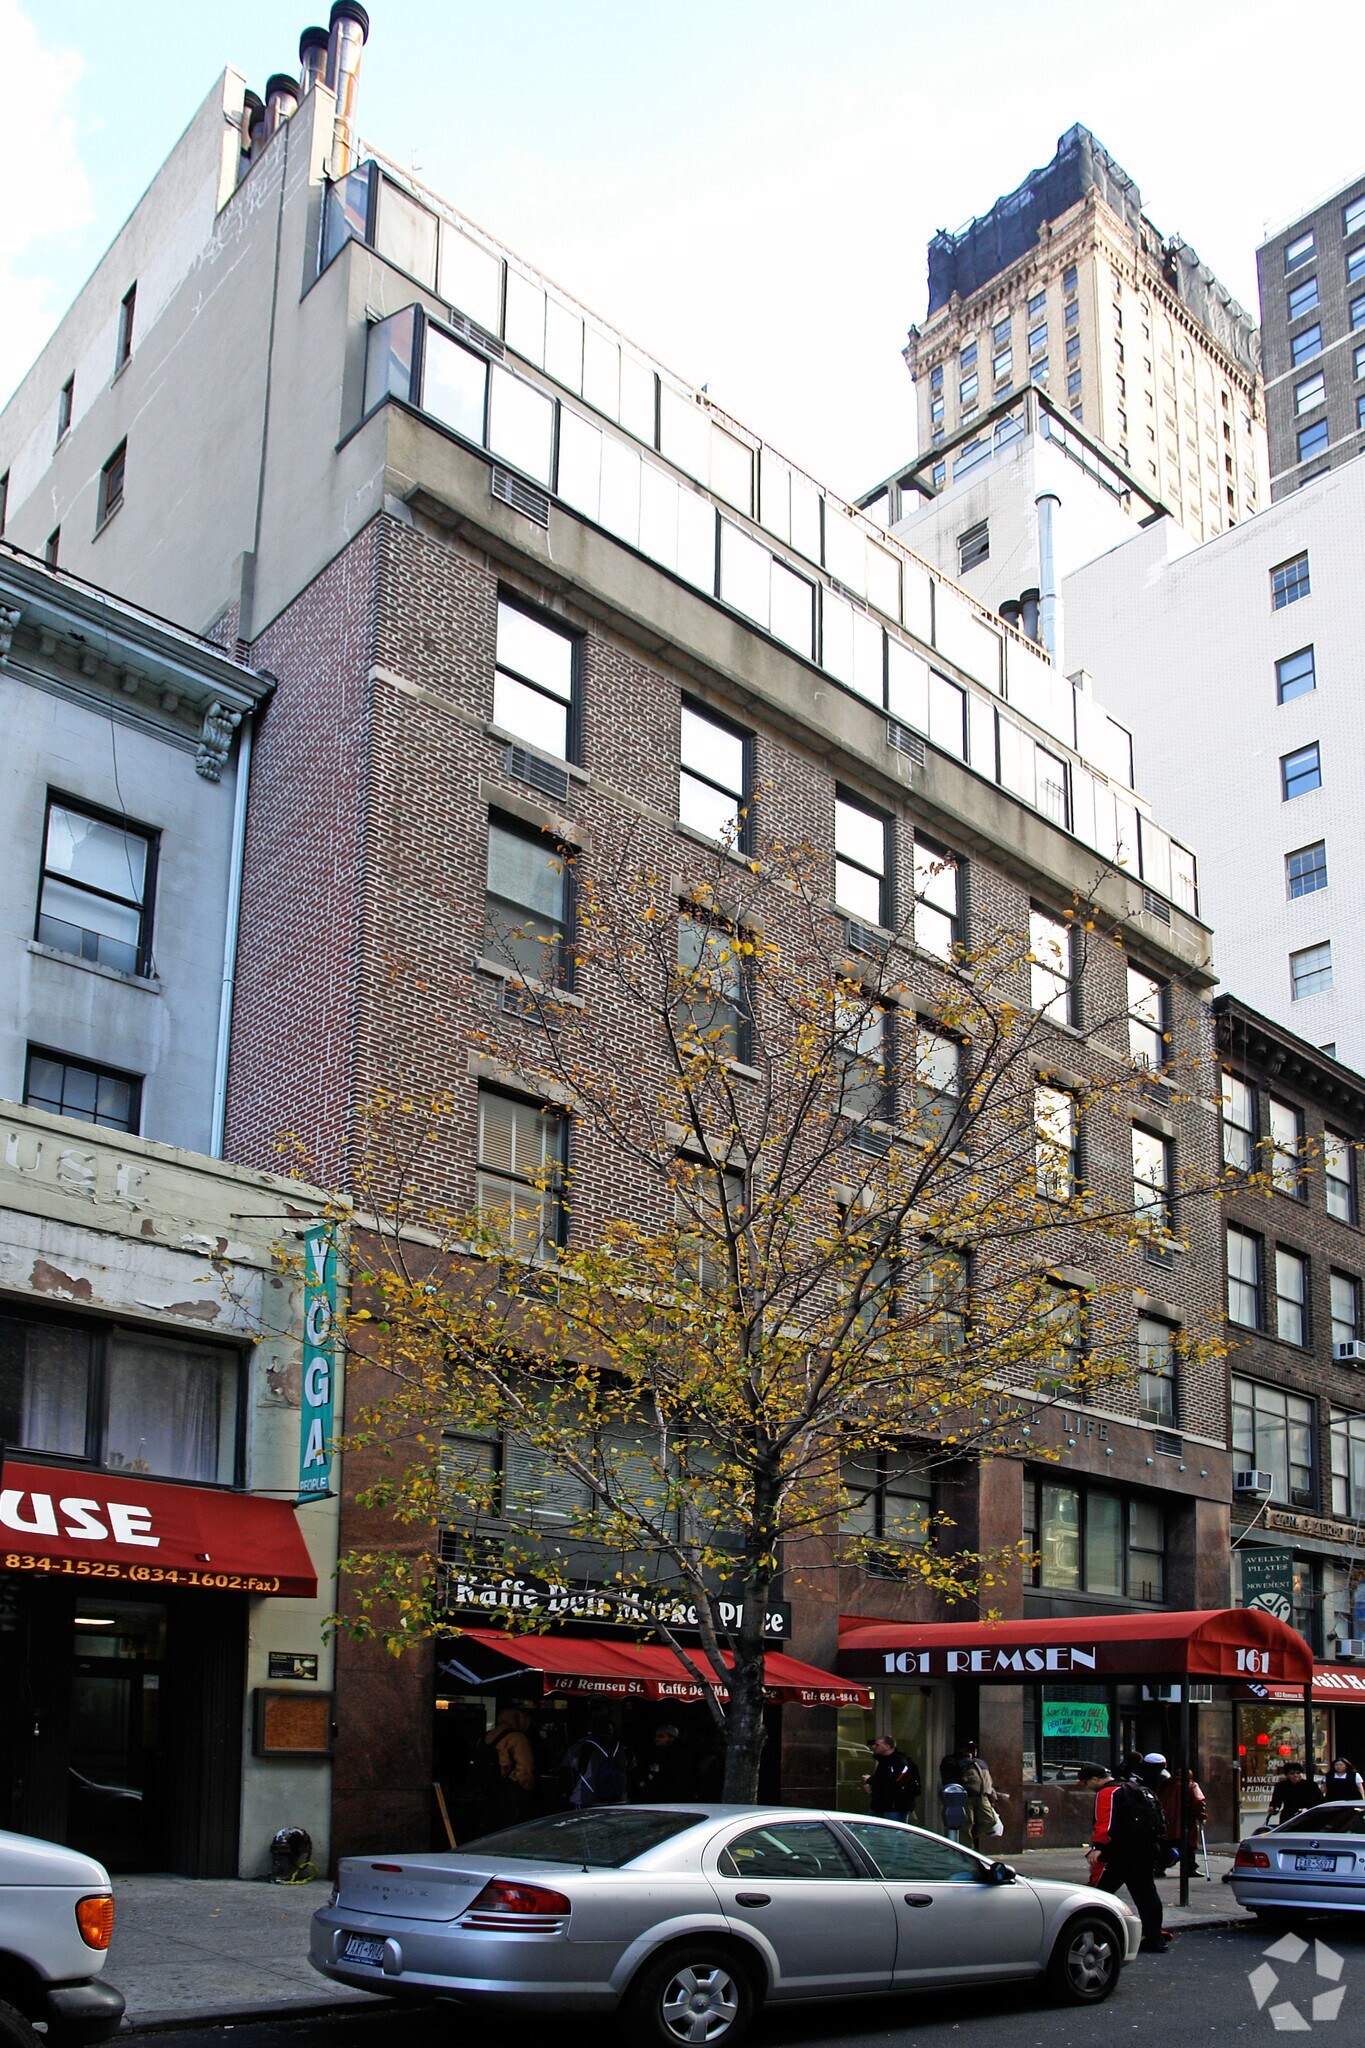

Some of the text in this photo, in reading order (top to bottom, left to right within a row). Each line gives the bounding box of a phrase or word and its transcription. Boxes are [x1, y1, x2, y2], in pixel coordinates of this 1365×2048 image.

[6, 1132, 150, 1203] USE
[303, 1233, 334, 1468] YOGA
[1063, 1413, 1109, 1441] LIFE
[1245, 1555, 1290, 1563] AVELLYN
[1248, 1564, 1288, 1572] PILATES
[1247, 1581, 1290, 1589] MOVEMENT
[719, 1602, 783, 1632] Plce
[882, 1646, 1096, 1673] 161 REMSEN
[1235, 1648, 1269, 1674] 161
[555, 1679, 573, 1688] 161
[577, 1679, 626, 1692] Remsen
[628, 1682, 644, 1693] St.
[658, 1682, 687, 1695] Kaffe
[801, 1690, 818, 1700] Tel:
